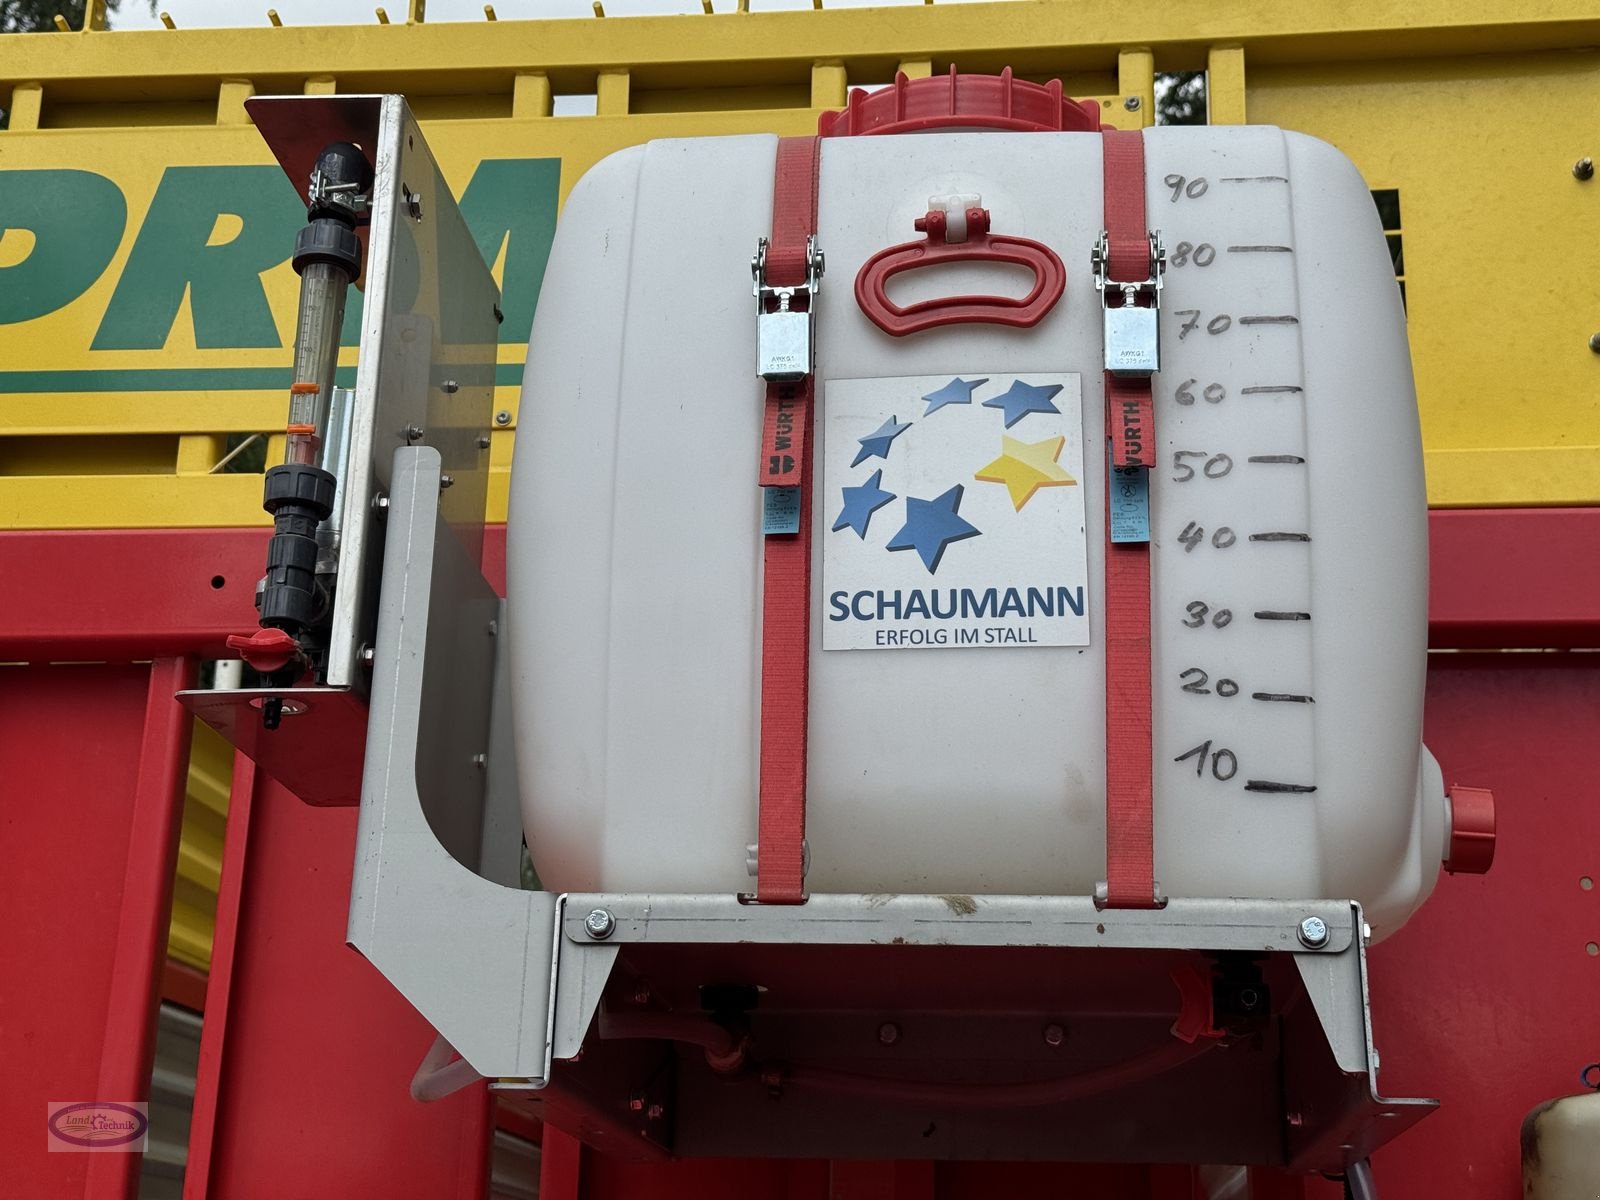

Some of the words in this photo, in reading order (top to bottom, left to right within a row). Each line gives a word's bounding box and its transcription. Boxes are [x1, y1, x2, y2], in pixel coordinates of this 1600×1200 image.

[1164, 174, 1209, 203] 90
[1170, 241, 1217, 268] 80
[1174, 309, 1232, 341] 70
[1174, 379, 1226, 406] 60
[1172, 450, 1234, 483] 50
[1177, 520, 1237, 553] 40
[829, 586, 1085, 622] SCHAUMANN
[1181, 600, 1233, 629] 30
[875, 629, 948, 646] ERFOLG
[954, 628, 980, 644] IM
[984, 627, 1038, 643] STALL
[1180, 667, 1239, 698] 20
[1174, 740, 1238, 781] 10
